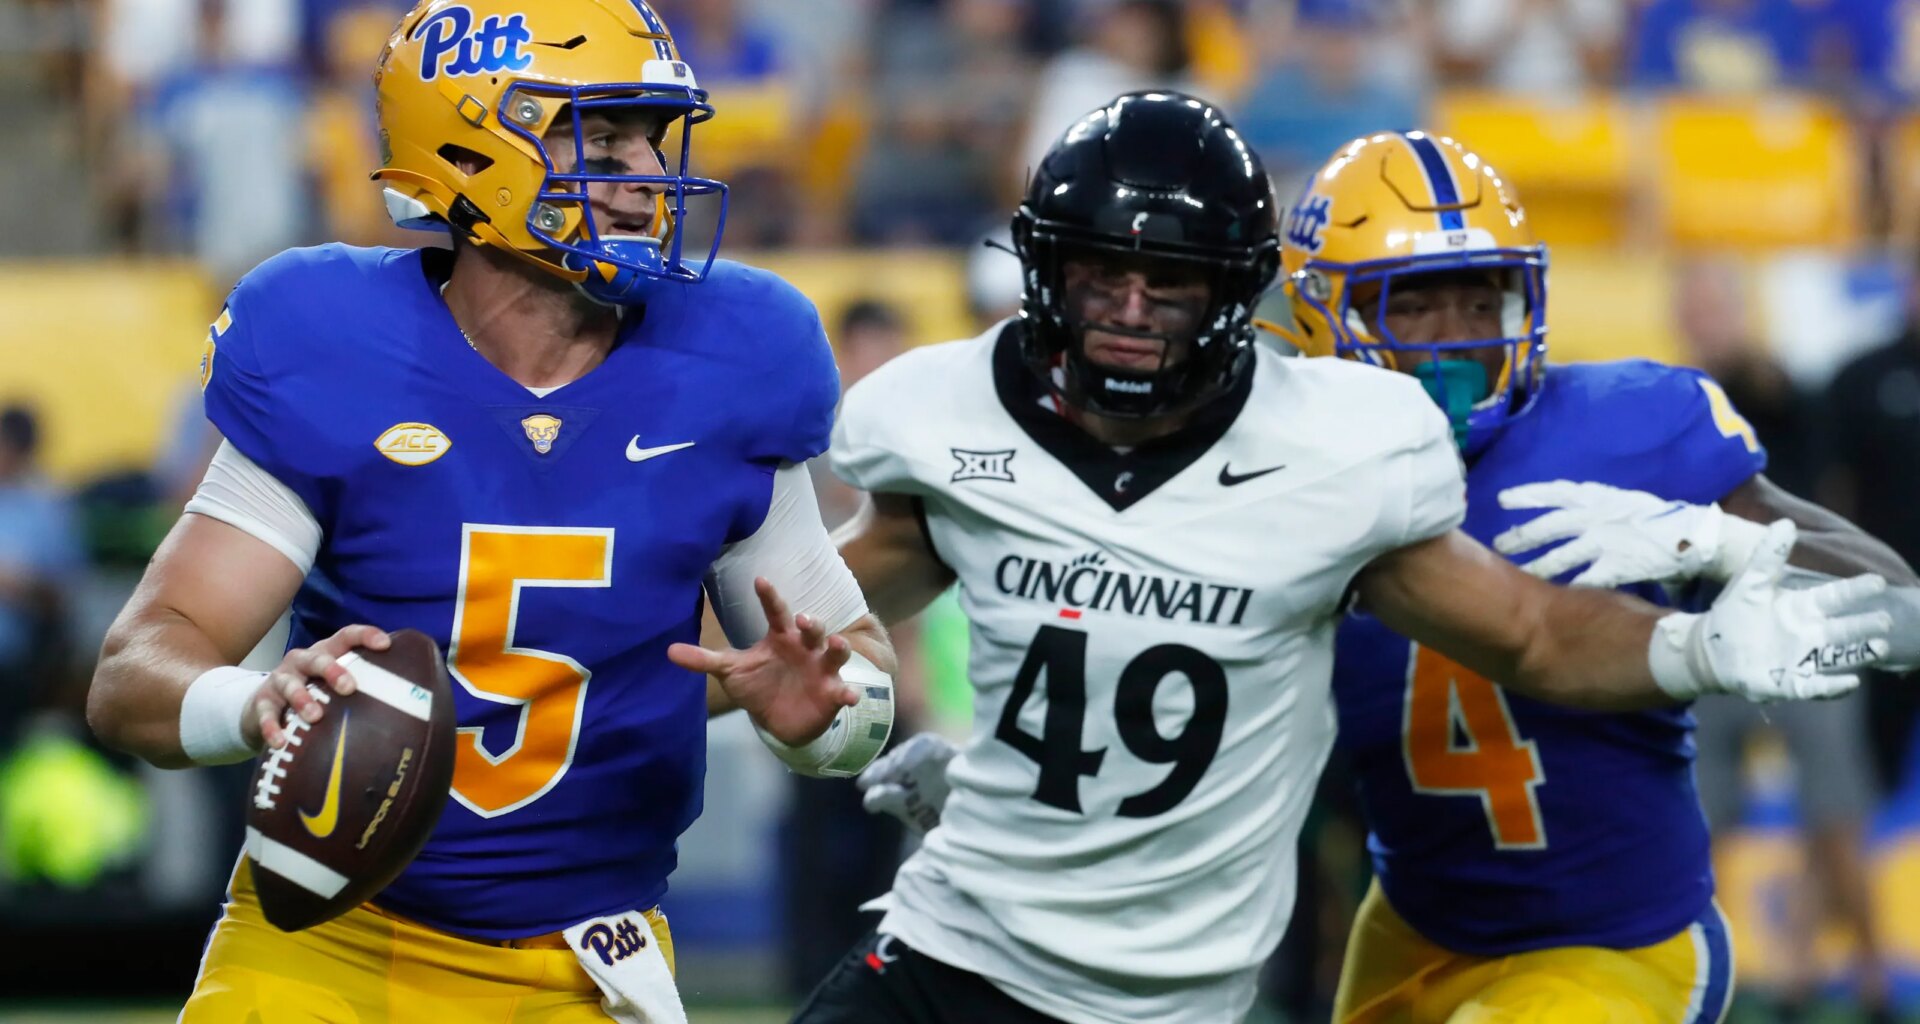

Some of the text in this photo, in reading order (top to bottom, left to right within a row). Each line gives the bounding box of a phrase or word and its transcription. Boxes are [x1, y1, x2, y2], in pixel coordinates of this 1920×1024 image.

[413, 5, 536, 80] Pitt
[1104, 377, 1152, 394] Riddell
[386, 433, 440, 449] ACC
[950, 448, 1016, 483] XII
[994, 552, 1255, 626] CINCINNATI
[447, 522, 615, 818] 5
[1798, 641, 1881, 670] ALPHA
[994, 623, 1229, 819] 49
[1402, 639, 1547, 850] 4
[581, 917, 647, 967] Pitt
